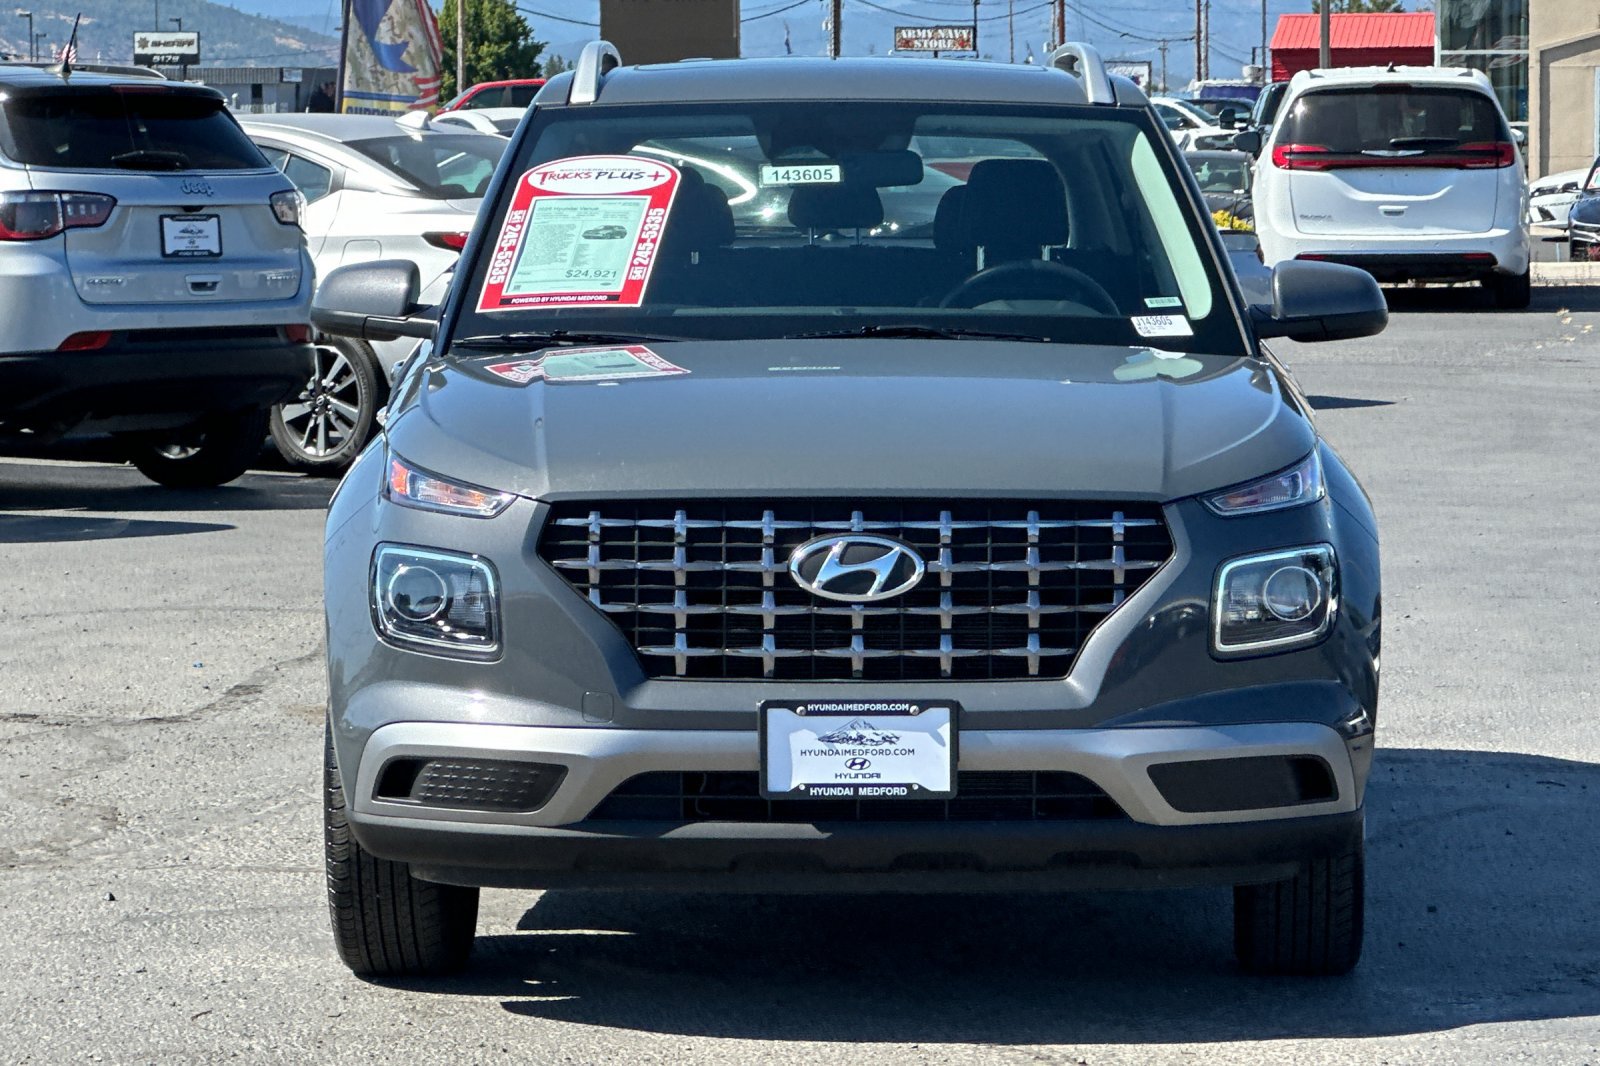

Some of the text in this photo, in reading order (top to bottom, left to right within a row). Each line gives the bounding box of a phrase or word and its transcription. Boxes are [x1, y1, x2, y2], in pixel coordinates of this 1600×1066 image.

[900, 28, 970, 39] ARMY NAVY
[914, 39, 954, 48] STORE
[536, 171, 592, 185] TRUCKS
[771, 168, 834, 182] 143605
[181, 179, 214, 197] Jeep
[564, 269, 618, 278] $24,921
[550, 295, 577, 303] HYUNDAI
[807, 703, 909, 712] HYUNDAIMEDFORD.COM
[800, 748, 916, 757] HYUNDAIMEDFORD.COM
[834, 772, 882, 780] HYUNDAI
[809, 786, 908, 796] HYUNDAI MEDFORD
